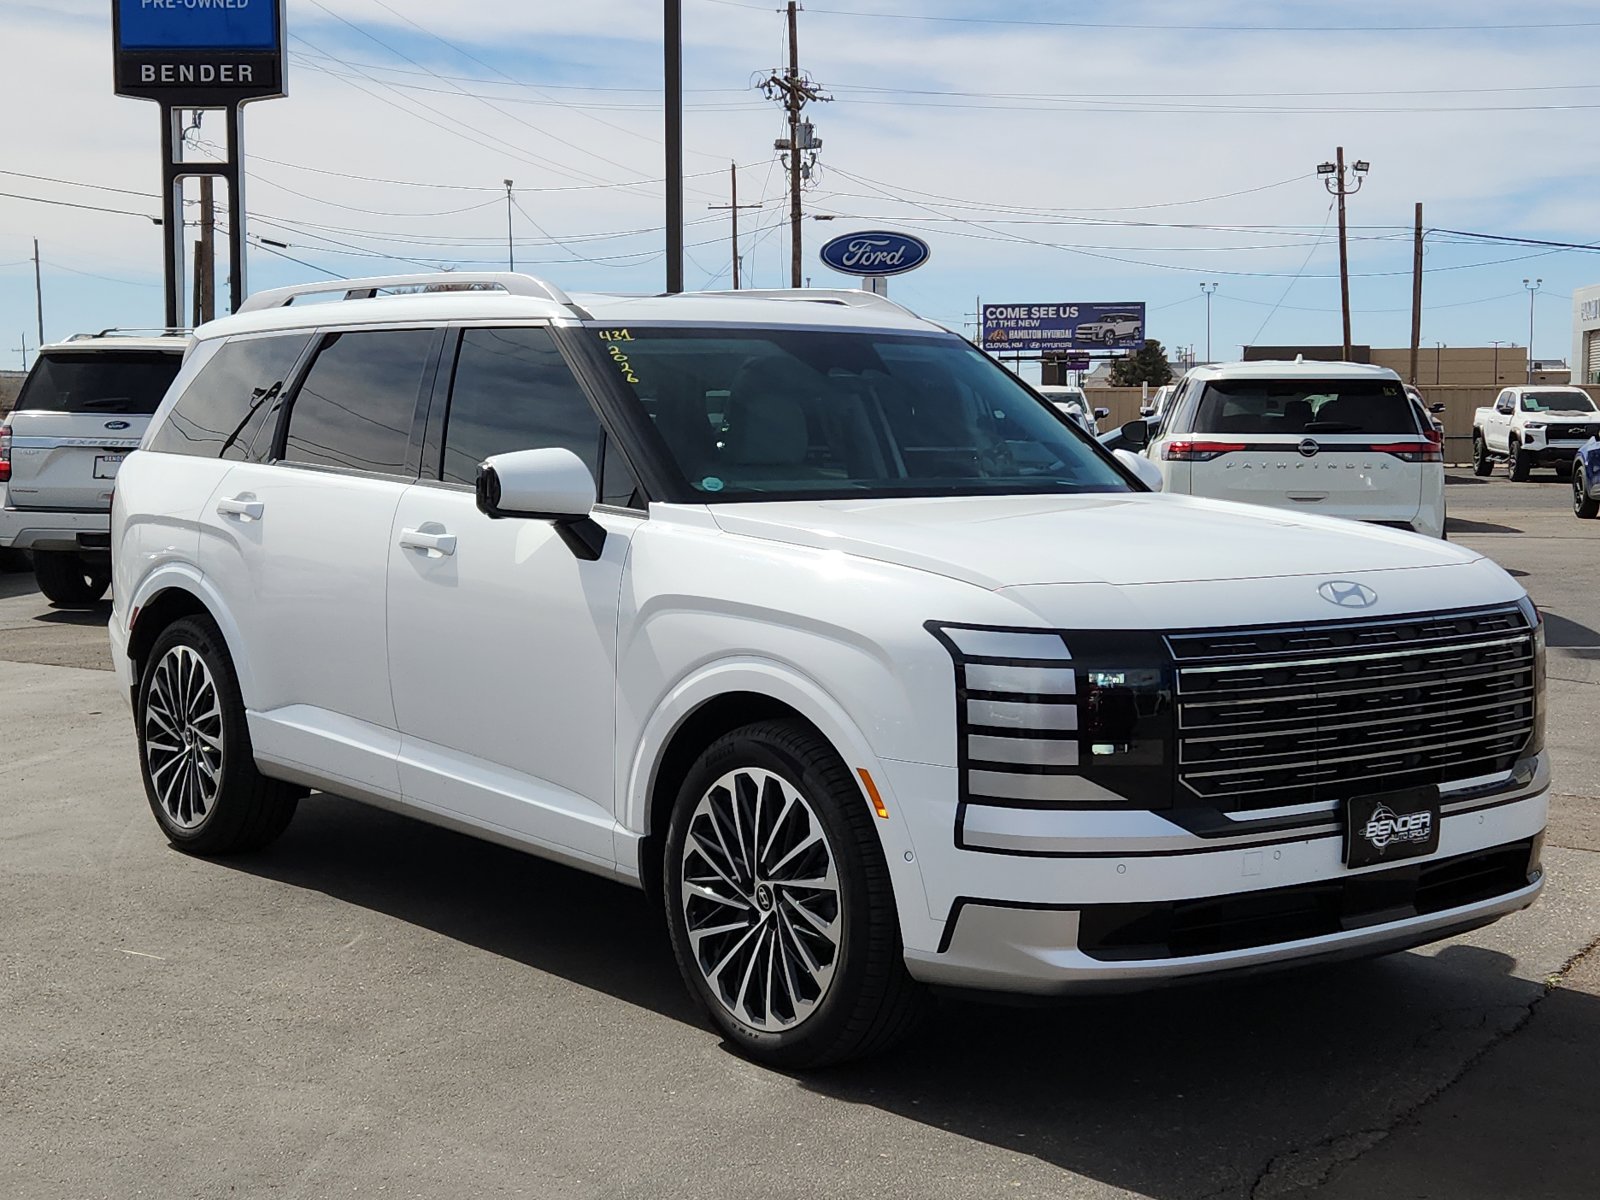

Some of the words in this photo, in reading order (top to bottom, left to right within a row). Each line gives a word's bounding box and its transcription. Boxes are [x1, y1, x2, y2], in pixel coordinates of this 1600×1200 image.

[141, 64, 253, 82] BENDER
[842, 239, 906, 266] Ford
[985, 307, 1029, 319] COME
[1030, 306, 1057, 318] SEE
[1059, 306, 1079, 317] US
[985, 320, 998, 328] AT
[999, 319, 1017, 328] THE
[1018, 319, 1041, 327] NEW
[1008, 330, 1042, 339] HAMILTON
[1042, 329, 1072, 339] HYUNDAI
[1366, 813, 1430, 837] BENDER
[1408, 827, 1430, 838] GROUP
